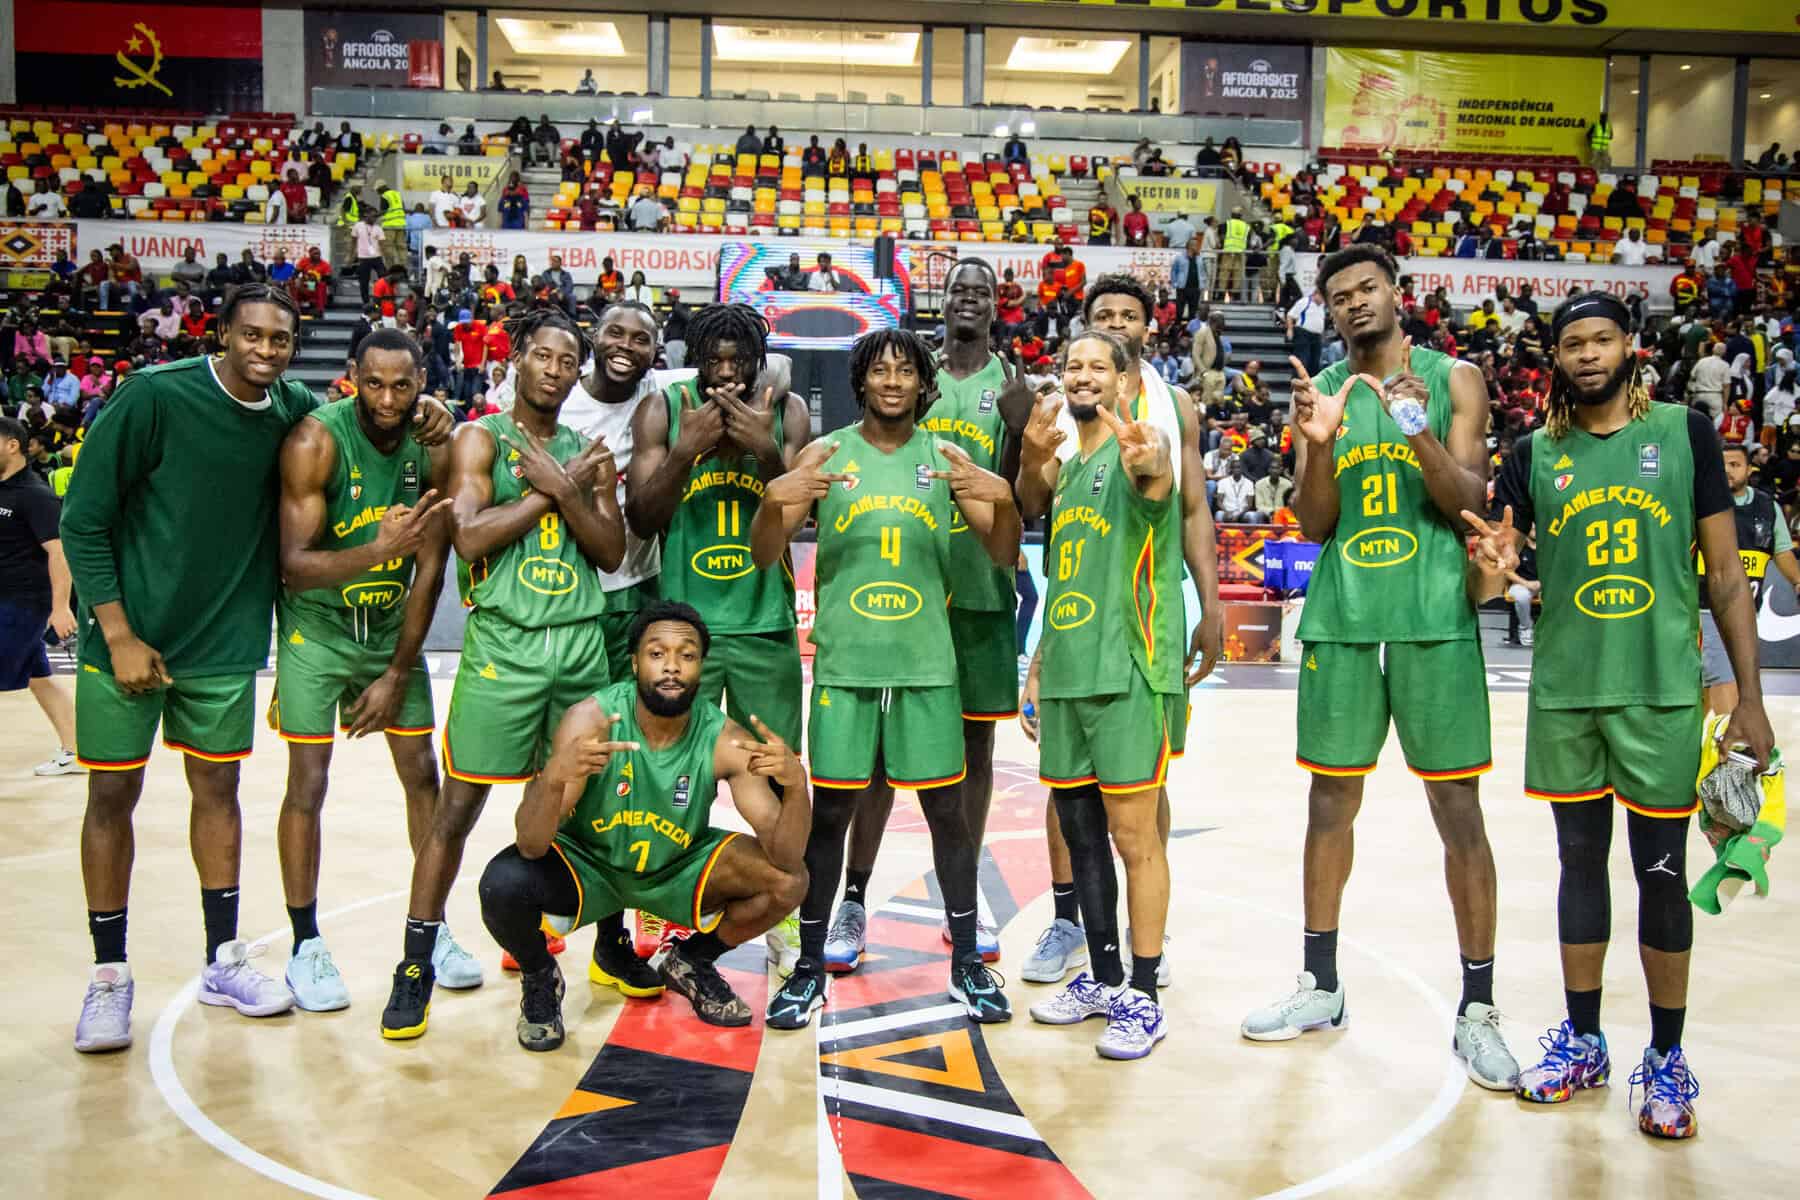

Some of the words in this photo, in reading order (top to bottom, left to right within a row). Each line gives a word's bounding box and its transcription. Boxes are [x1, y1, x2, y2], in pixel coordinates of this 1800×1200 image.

[343, 43, 408, 57] AFROBASK
[343, 59, 391, 69] ANGOLA
[394, 59, 408, 69] 20
[1222, 73, 1298, 87] AFROBASKET
[1222, 88, 1268, 98] ANGOLA
[1271, 88, 1298, 99] 2025
[1457, 98, 1555, 113] INDEPENDÊNCIA
[1457, 113, 1517, 126] NACIONAL
[1519, 116, 1536, 126] DE
[1537, 116, 1587, 129] ANGOLA
[423, 164, 472, 177] SECTOR
[477, 166, 490, 178] 12
[1135, 186, 1181, 199] SECTOR
[1185, 188, 1199, 201] 10
[1409, 273, 1454, 293] FIBA
[1362, 473, 1398, 517] 21
[718, 500, 739, 537] 11
[540, 512, 560, 550] 8
[880, 526, 901, 567] 4
[1360, 538, 1400, 557] MTN
[1586, 518, 1637, 567] 23
[707, 554, 743, 569] MTN
[532, 565, 565, 585] MTN
[359, 590, 393, 605] MTN
[867, 593, 906, 609] MTN
[1593, 588, 1635, 606] MTN
[628, 840, 650, 873] 7
